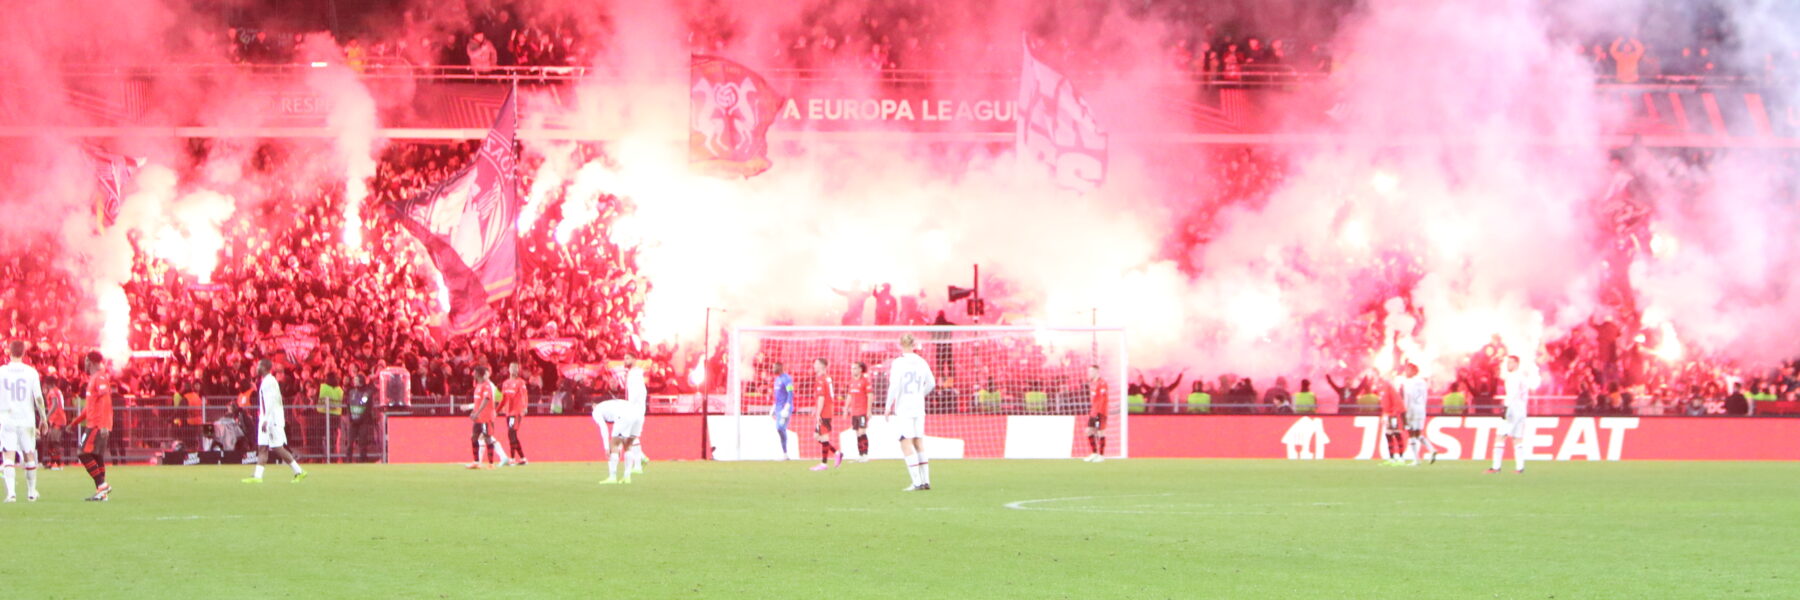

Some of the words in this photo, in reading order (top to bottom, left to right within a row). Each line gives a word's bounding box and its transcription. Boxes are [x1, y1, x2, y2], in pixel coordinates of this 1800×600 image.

[281, 97, 337, 113] RESPE
[783, 98, 800, 120] A
[808, 98, 915, 121] EUROPA
[3, 378, 27, 402] 46
[903, 371, 922, 394] 24
[1521, 416, 1640, 461] EAT
